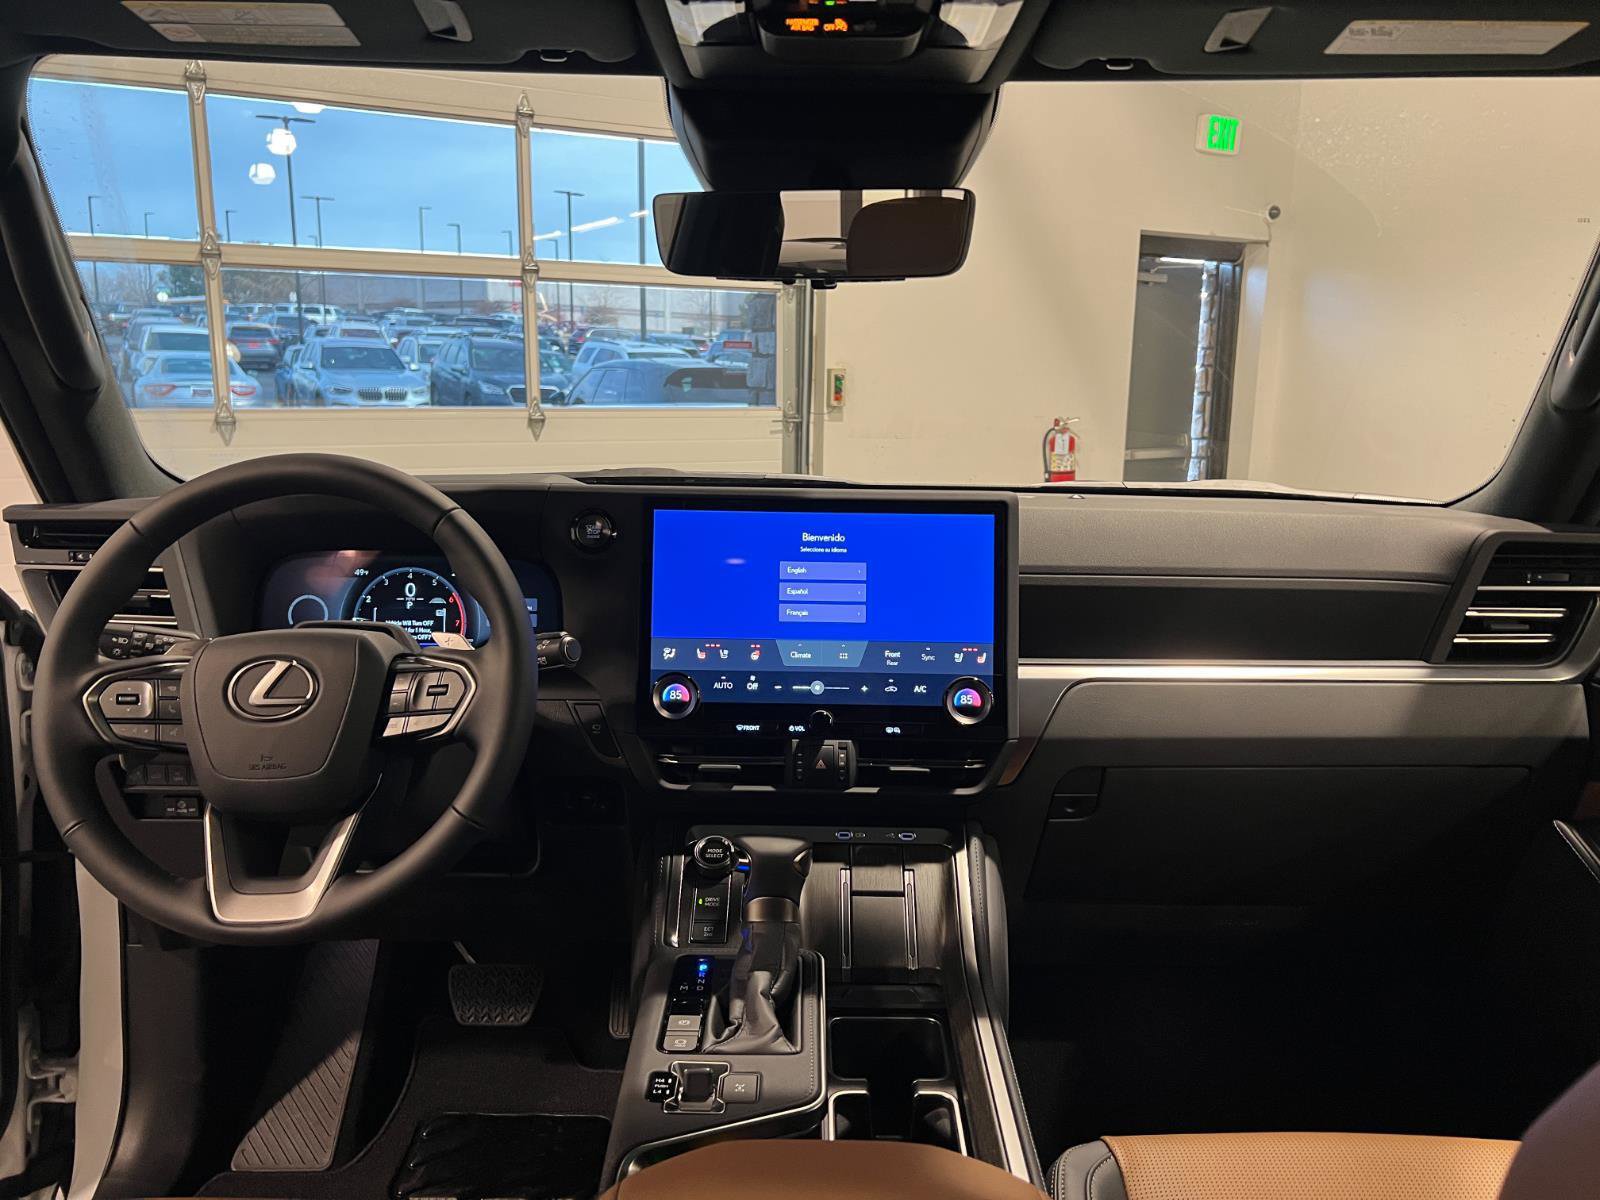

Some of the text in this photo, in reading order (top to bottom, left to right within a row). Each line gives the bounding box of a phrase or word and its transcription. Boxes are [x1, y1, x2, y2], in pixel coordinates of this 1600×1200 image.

[1207, 115, 1239, 152] EXIT
[802, 532, 846, 542] Bienvenido
[787, 566, 807, 575] English
[404, 582, 416, 597] 0
[786, 587, 809, 596] Español
[790, 651, 811, 659] Climate
[884, 650, 900, 658] Front
[921, 653, 935, 662] Sync
[713, 682, 733, 690] AUTO
[747, 682, 759, 690] Off
[913, 685, 927, 693] A/C
[669, 690, 682, 700] 85
[960, 694, 973, 705] 85
